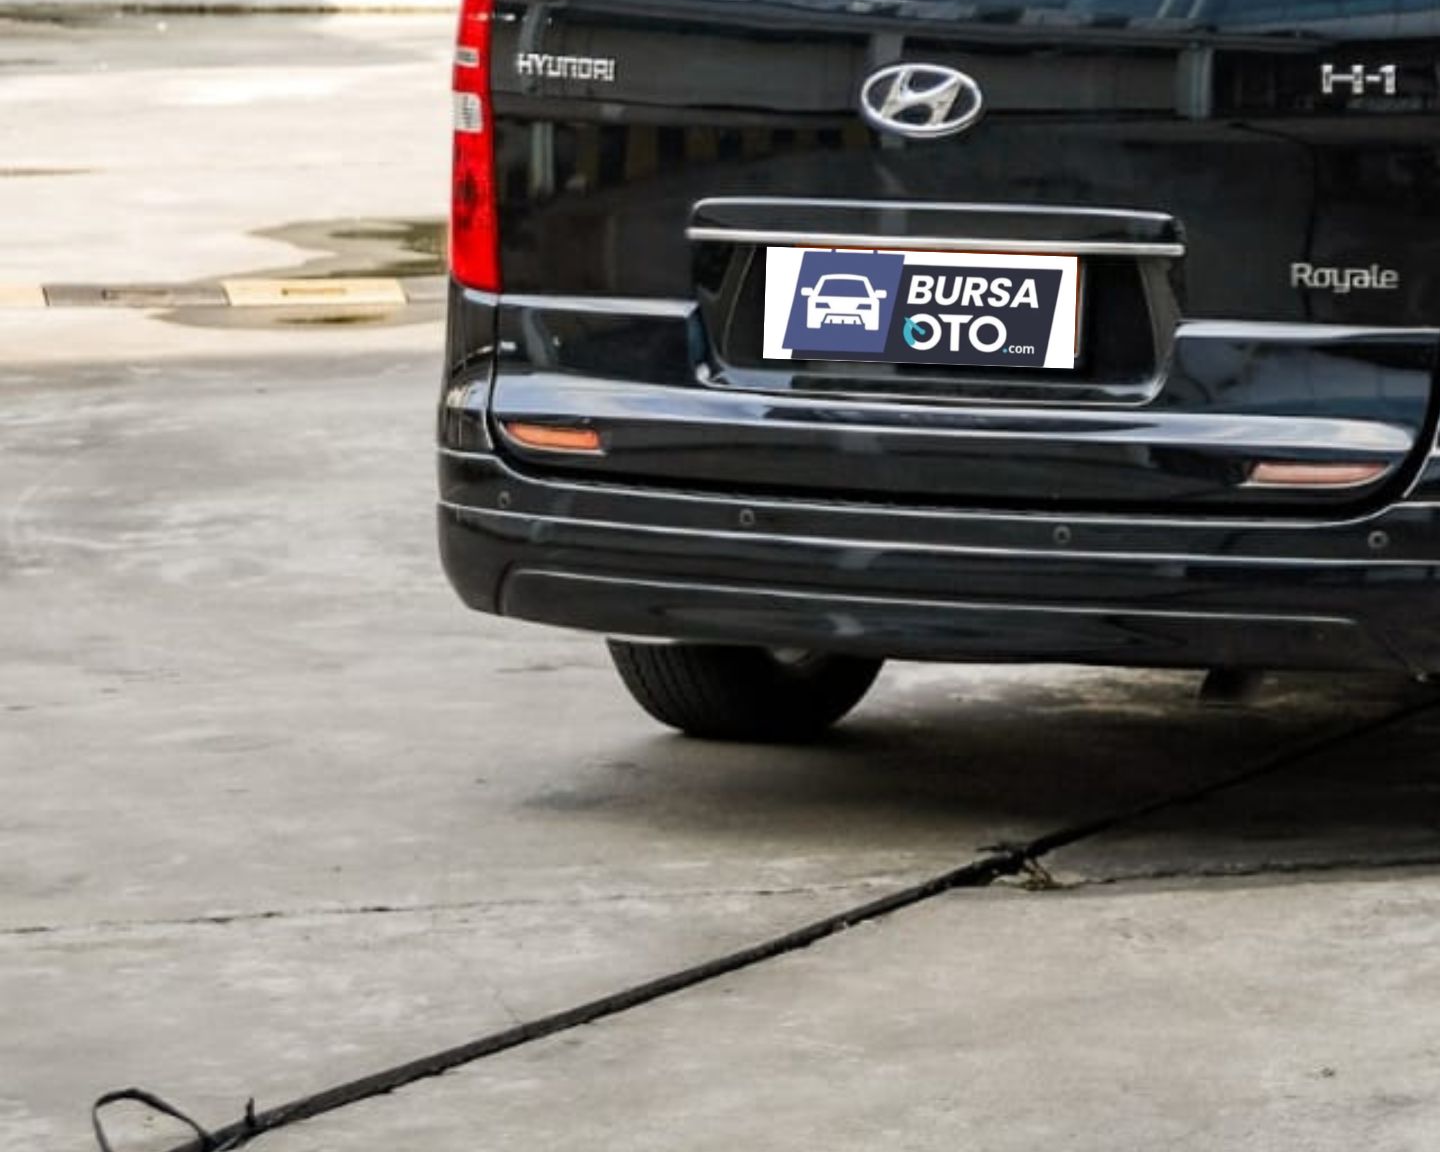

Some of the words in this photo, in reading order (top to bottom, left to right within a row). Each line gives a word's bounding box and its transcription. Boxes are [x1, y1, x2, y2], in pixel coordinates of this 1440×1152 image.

[517, 53, 616, 82] HYUNDAI
[1321, 64, 1396, 94] H-1
[1290, 262, 1399, 294] Royale
